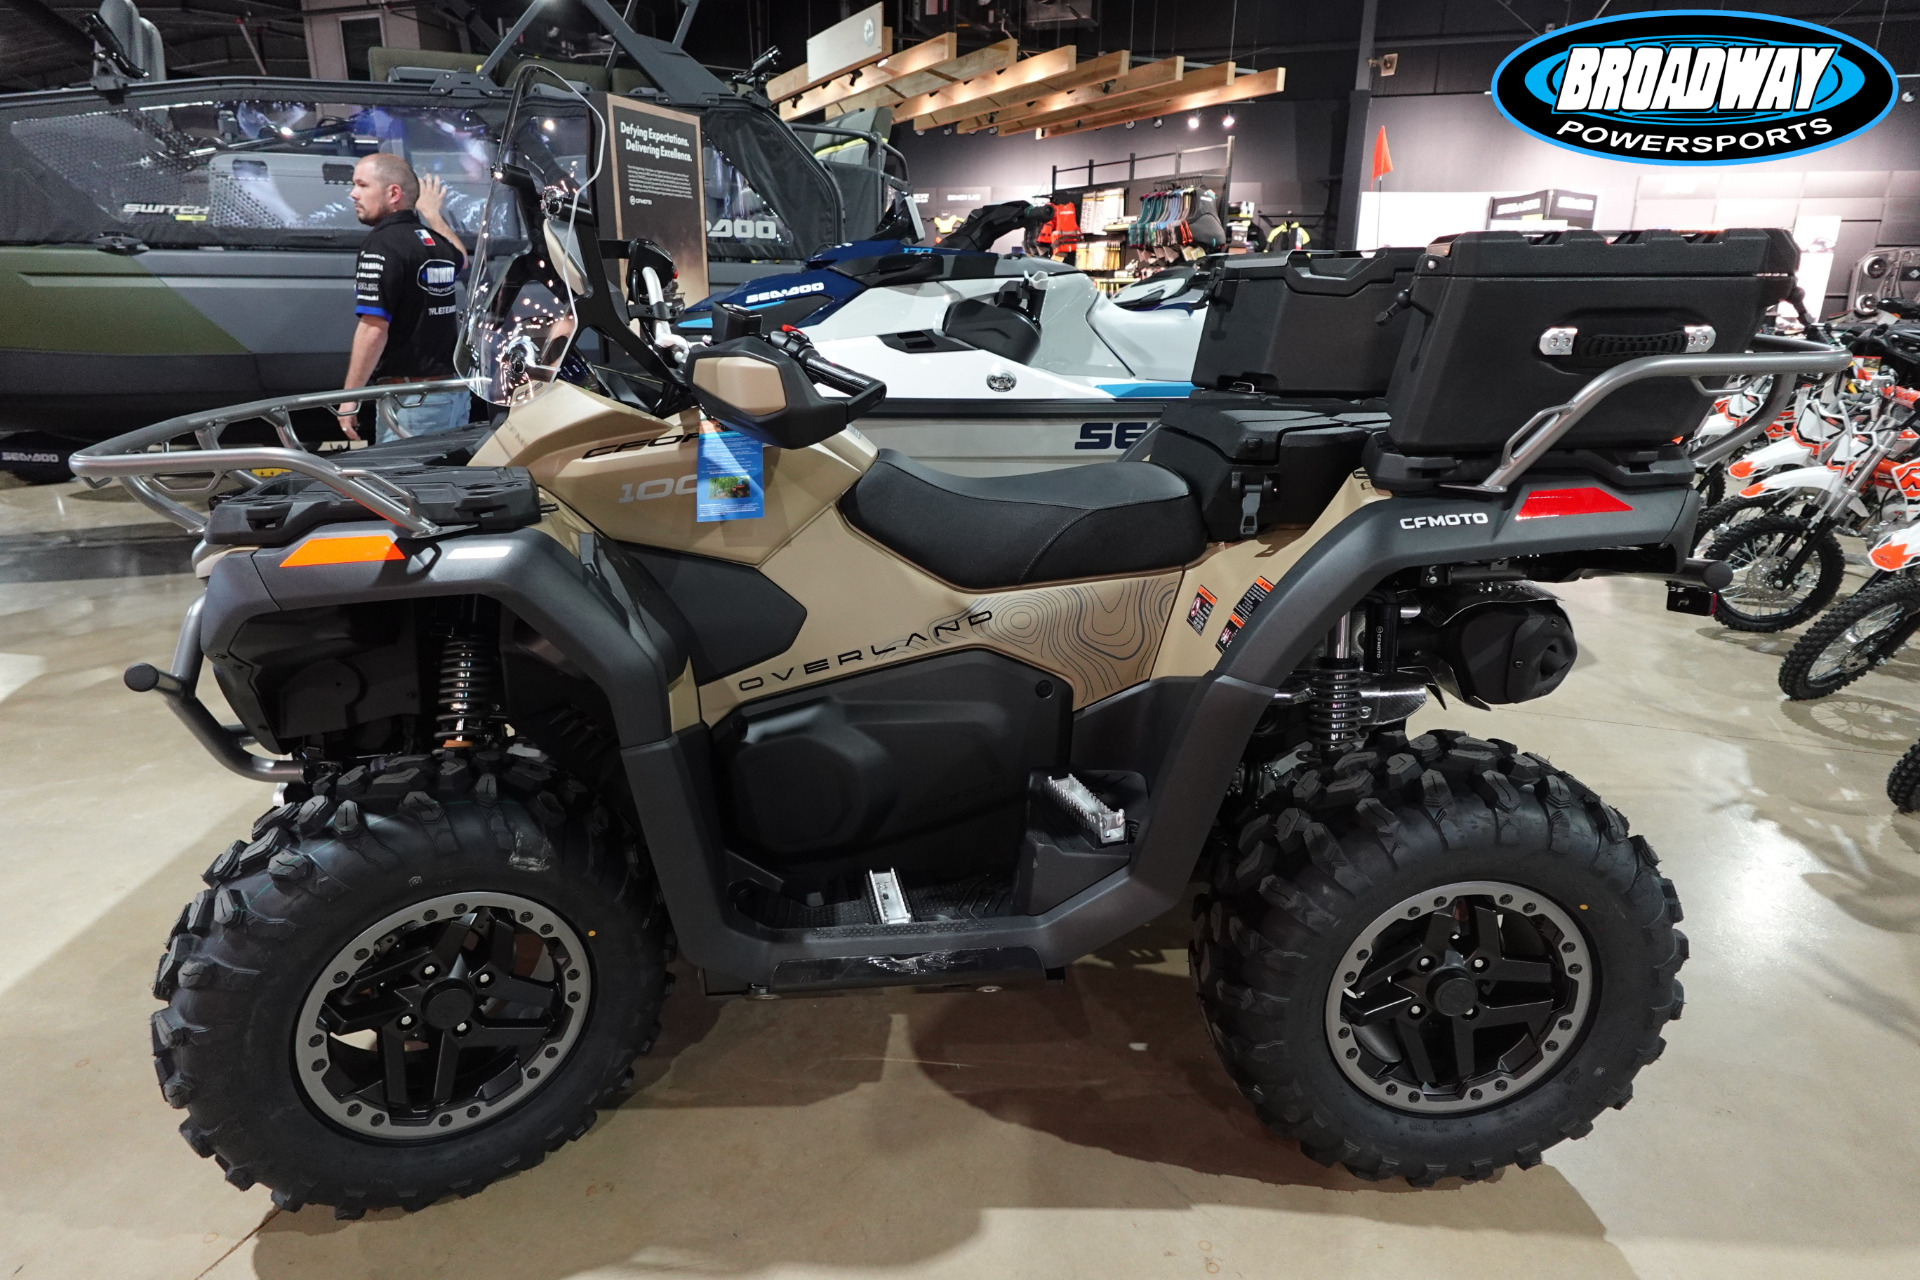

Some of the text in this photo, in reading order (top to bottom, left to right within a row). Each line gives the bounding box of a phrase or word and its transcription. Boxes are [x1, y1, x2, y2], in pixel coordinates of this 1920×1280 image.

[620, 121, 690, 147] Defying Expectations.
[625, 138, 693, 162] Delivering Excellence.
[123, 203, 210, 214] SWITCH
[745, 282, 824, 303] SEA-DOO
[1074, 422, 1148, 450] SE
[2, 451, 60, 463] SEA-DOO
[618, 473, 698, 504] 100
[1399, 512, 1489, 530] CFMOTO
[738, 610, 993, 691] OVERLAND
